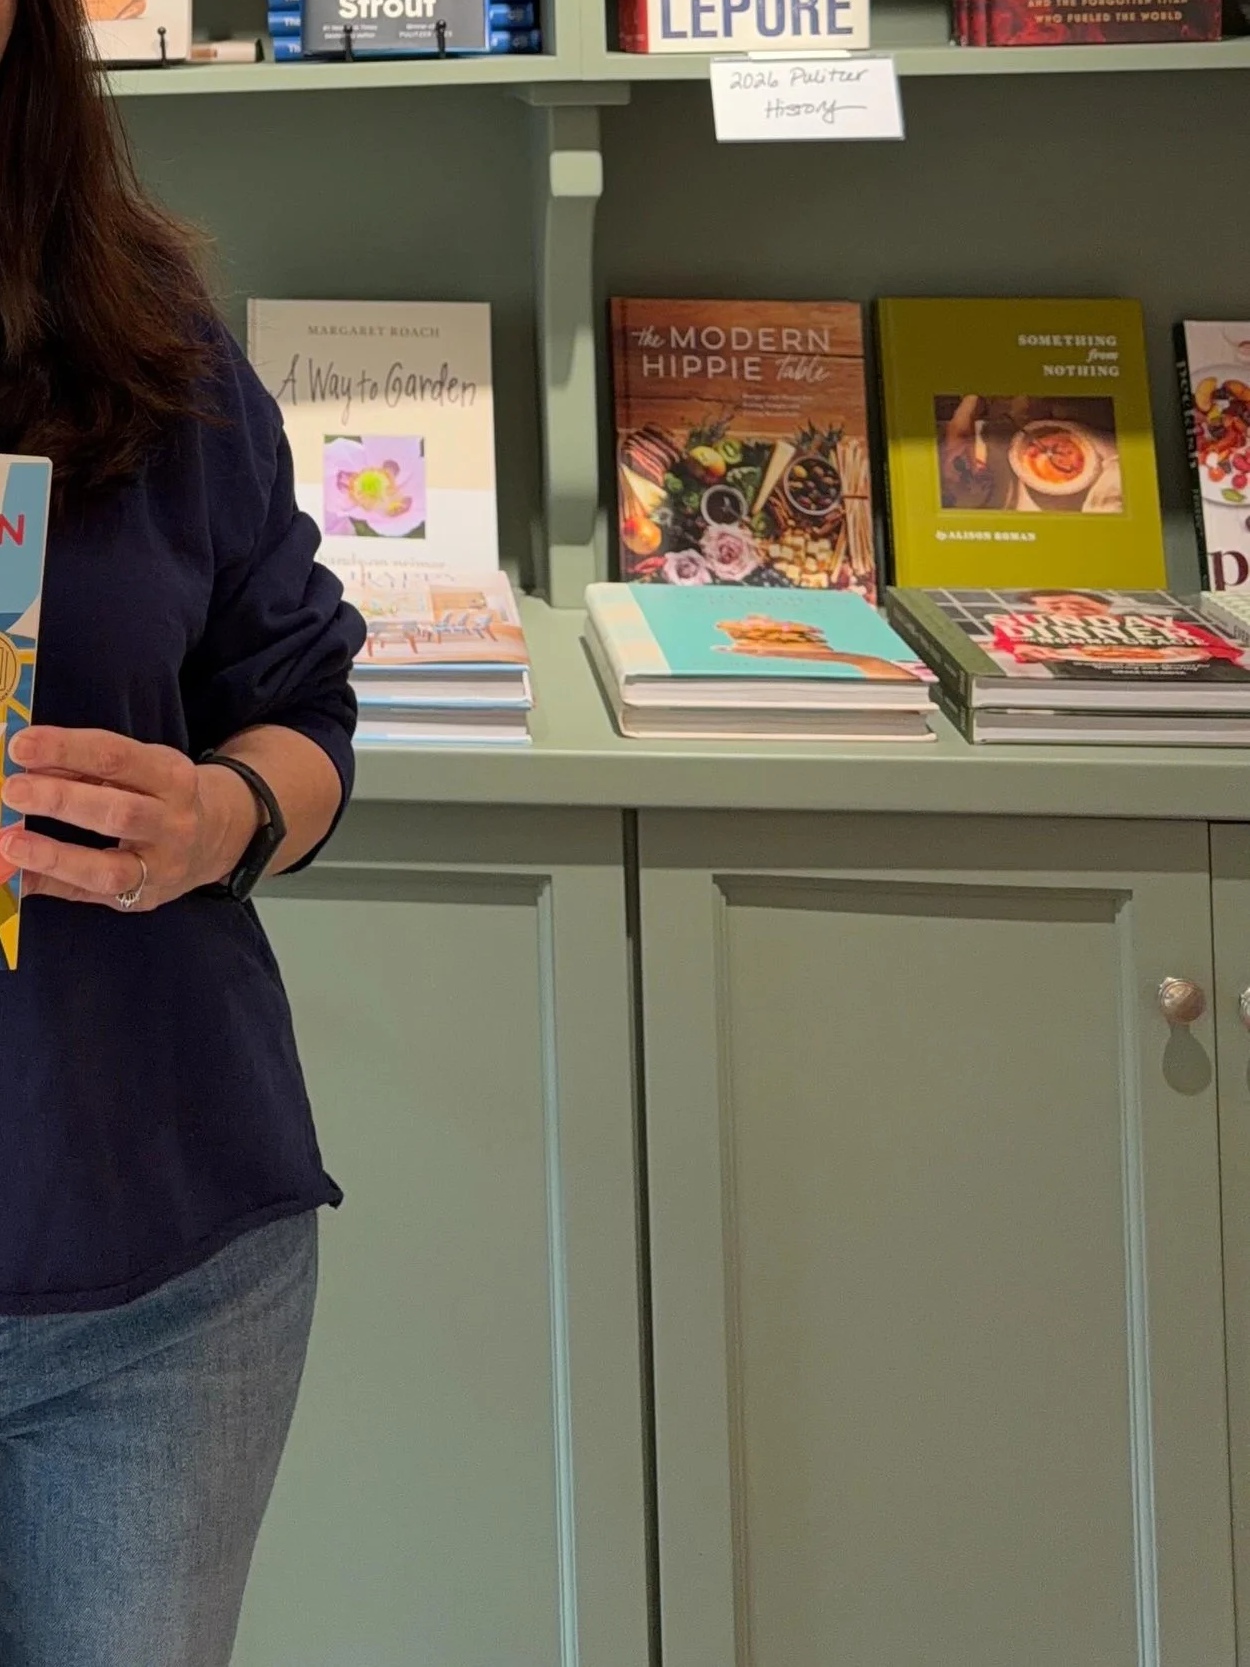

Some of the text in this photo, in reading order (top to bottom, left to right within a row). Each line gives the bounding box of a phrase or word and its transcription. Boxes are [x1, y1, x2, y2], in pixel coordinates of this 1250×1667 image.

[731, 71, 778, 91] 2026
[307, 325, 440, 337] MARGARET ROACH
[631, 325, 831, 353] the MODERN
[1018, 334, 1118, 347] SOMETHING
[1087, 349, 1119, 362] from
[641, 354, 832, 384] HIPPIE Table
[1043, 365, 1120, 377] NOTHING
[270, 353, 476, 426] A Way to Garden
[983, 614, 1175, 628] SUNDAY
[1002, 625, 1190, 639] DINNER
